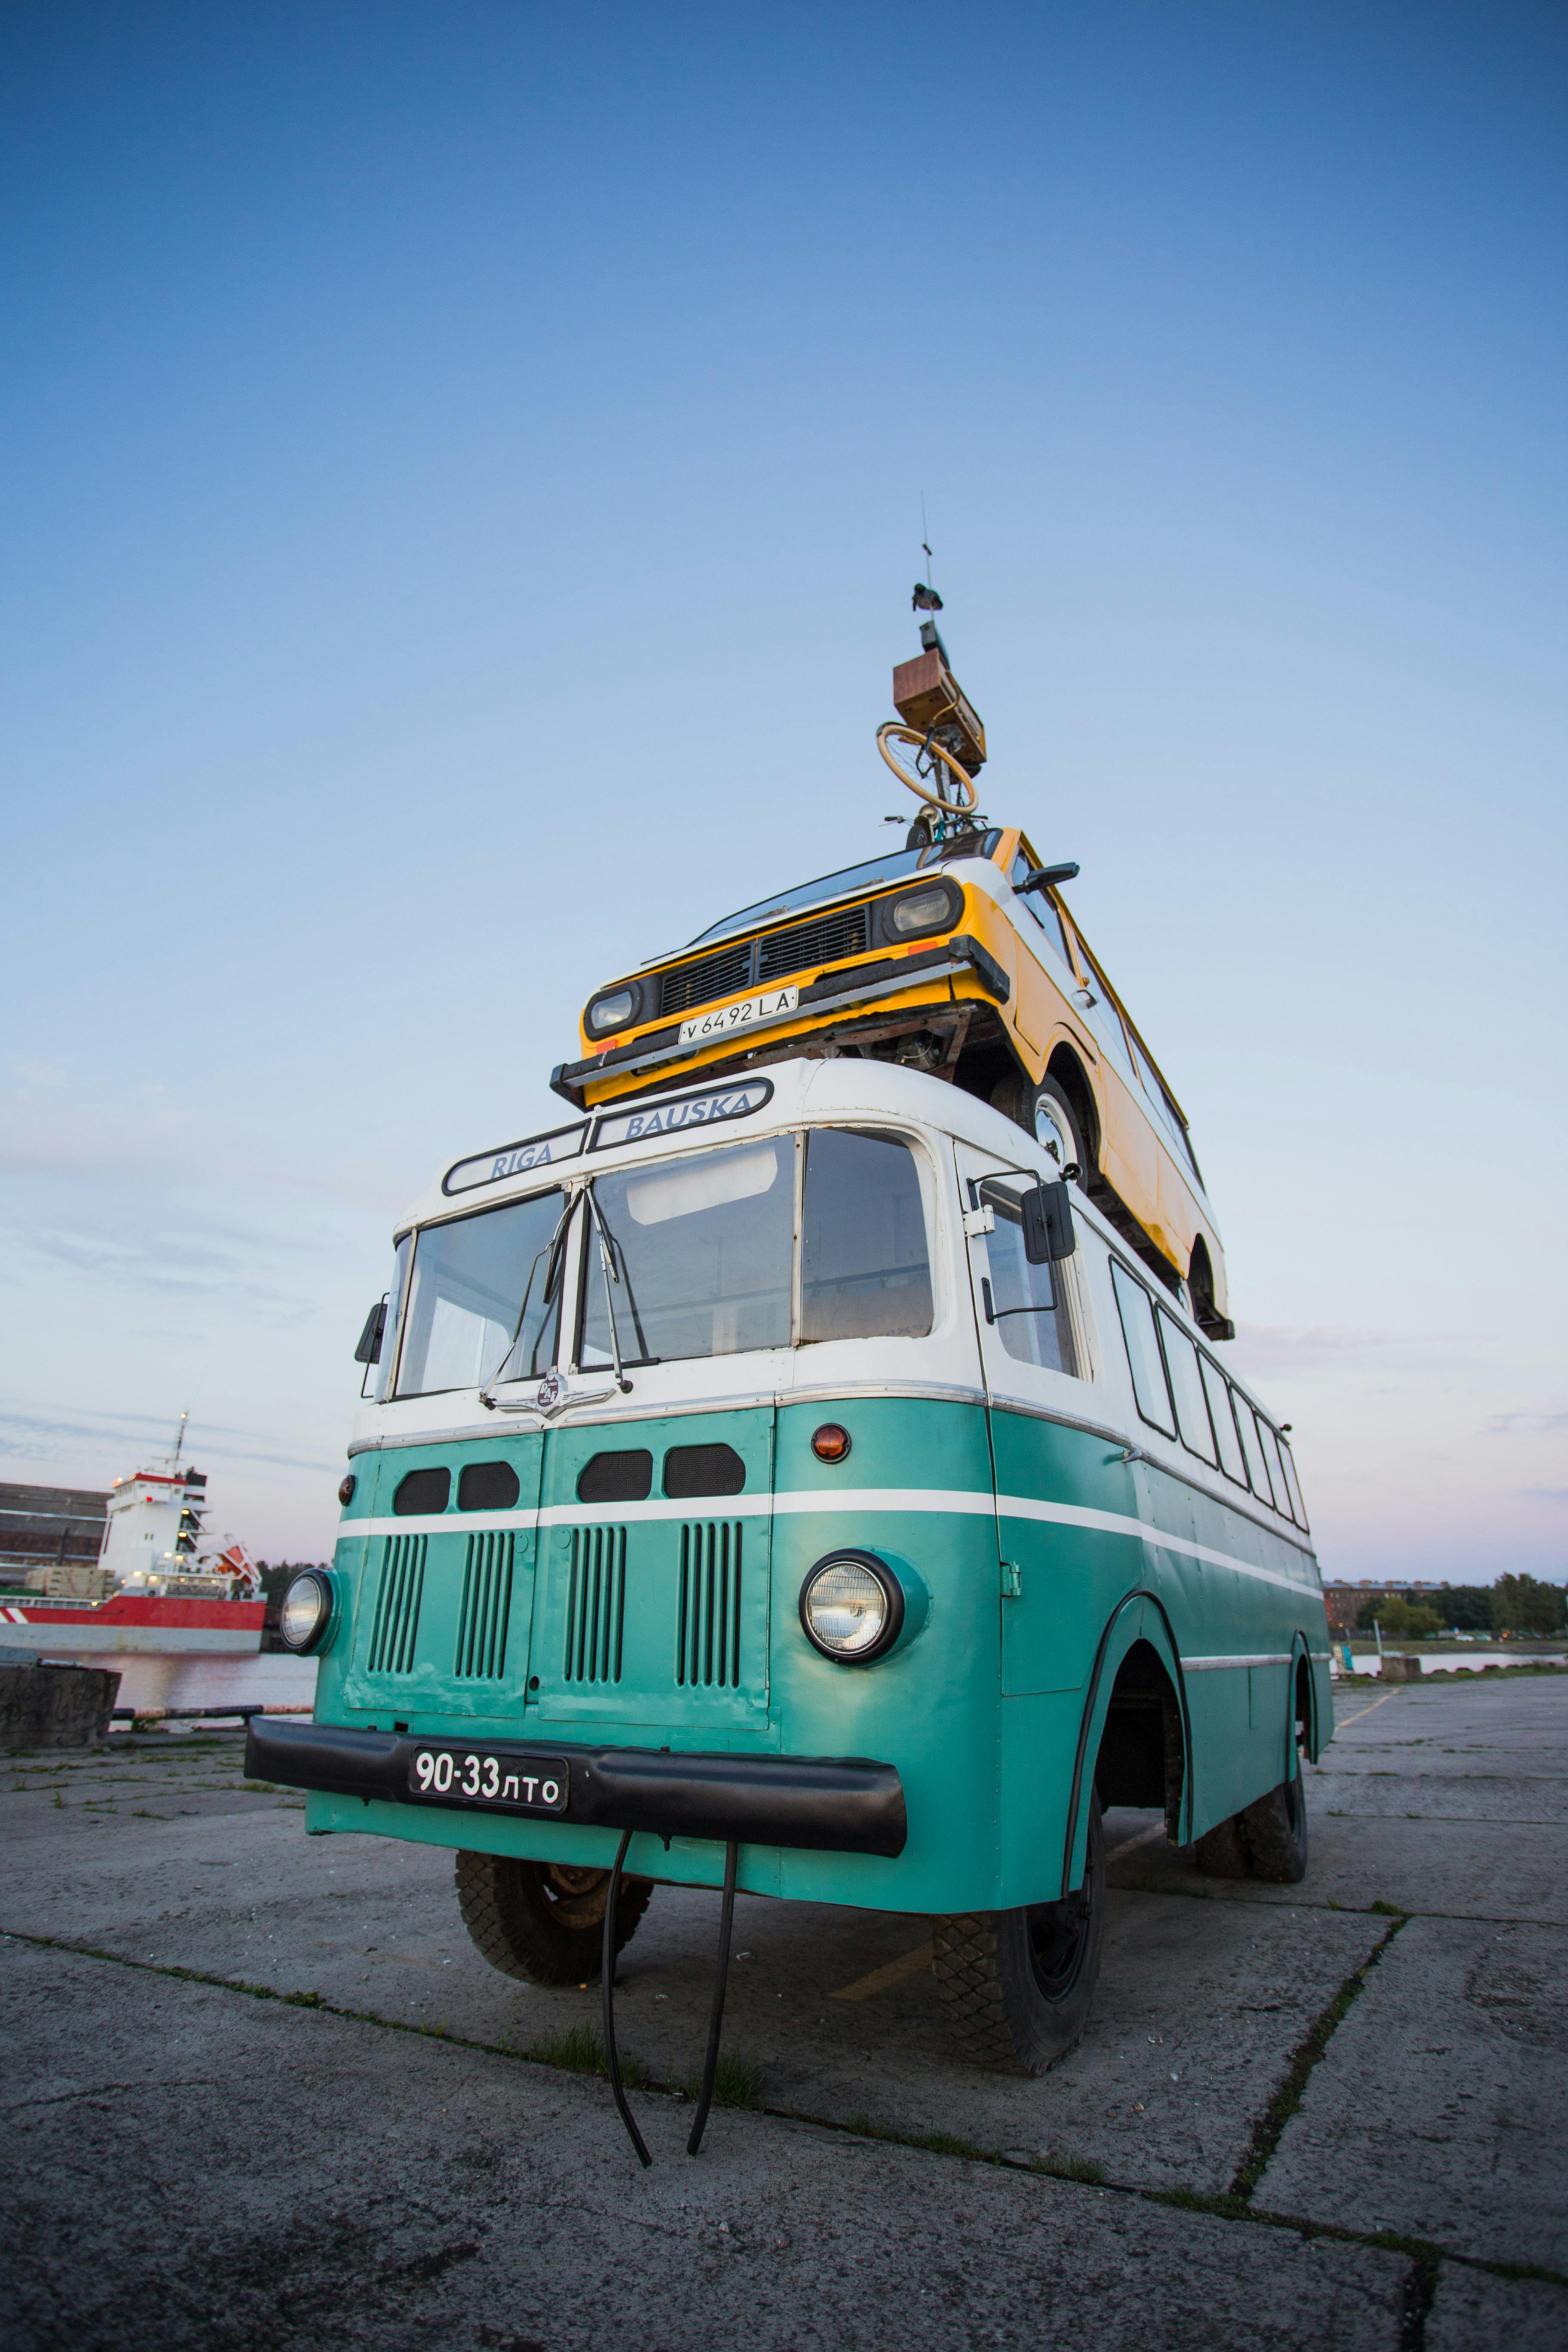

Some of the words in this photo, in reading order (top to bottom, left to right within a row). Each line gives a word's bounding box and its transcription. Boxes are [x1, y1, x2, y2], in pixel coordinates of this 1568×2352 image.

[490, 1142, 551, 1179] RIGA
[625, 1093, 751, 1139] BAUSKA
[539, 1382, 557, 1403] RAF
